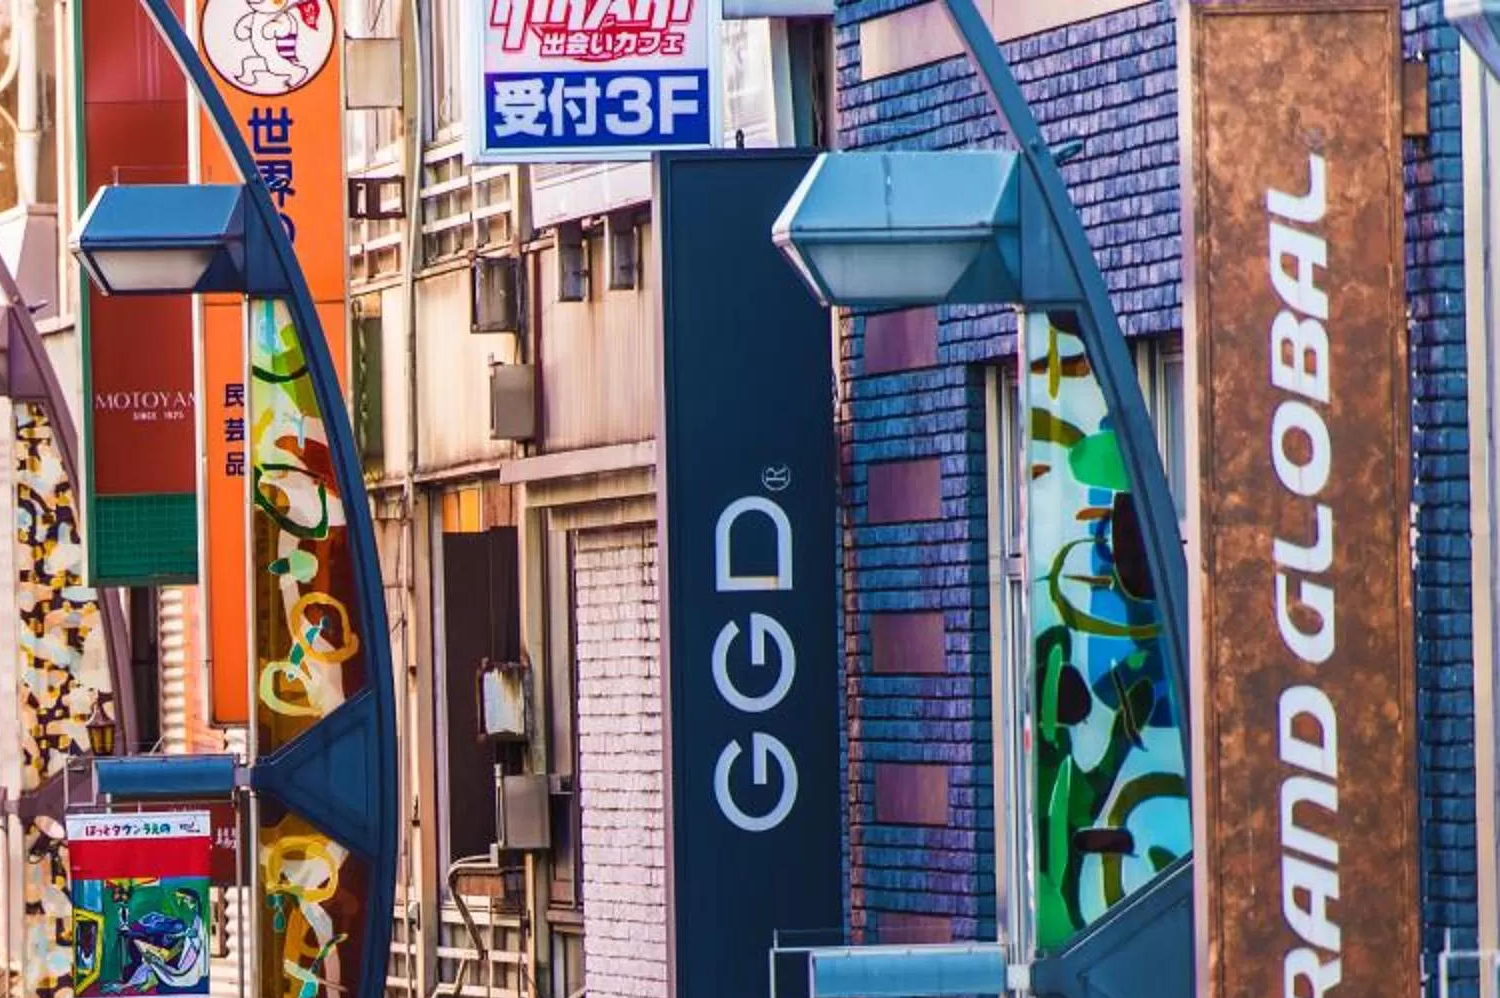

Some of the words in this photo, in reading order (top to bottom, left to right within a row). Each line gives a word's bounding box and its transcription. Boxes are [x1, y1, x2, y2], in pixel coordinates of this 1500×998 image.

[542, 31, 685, 55] 出会いカフェ
[493, 76, 699, 137] 受付3F
[1266, 154, 1335, 664] GLOBAL
